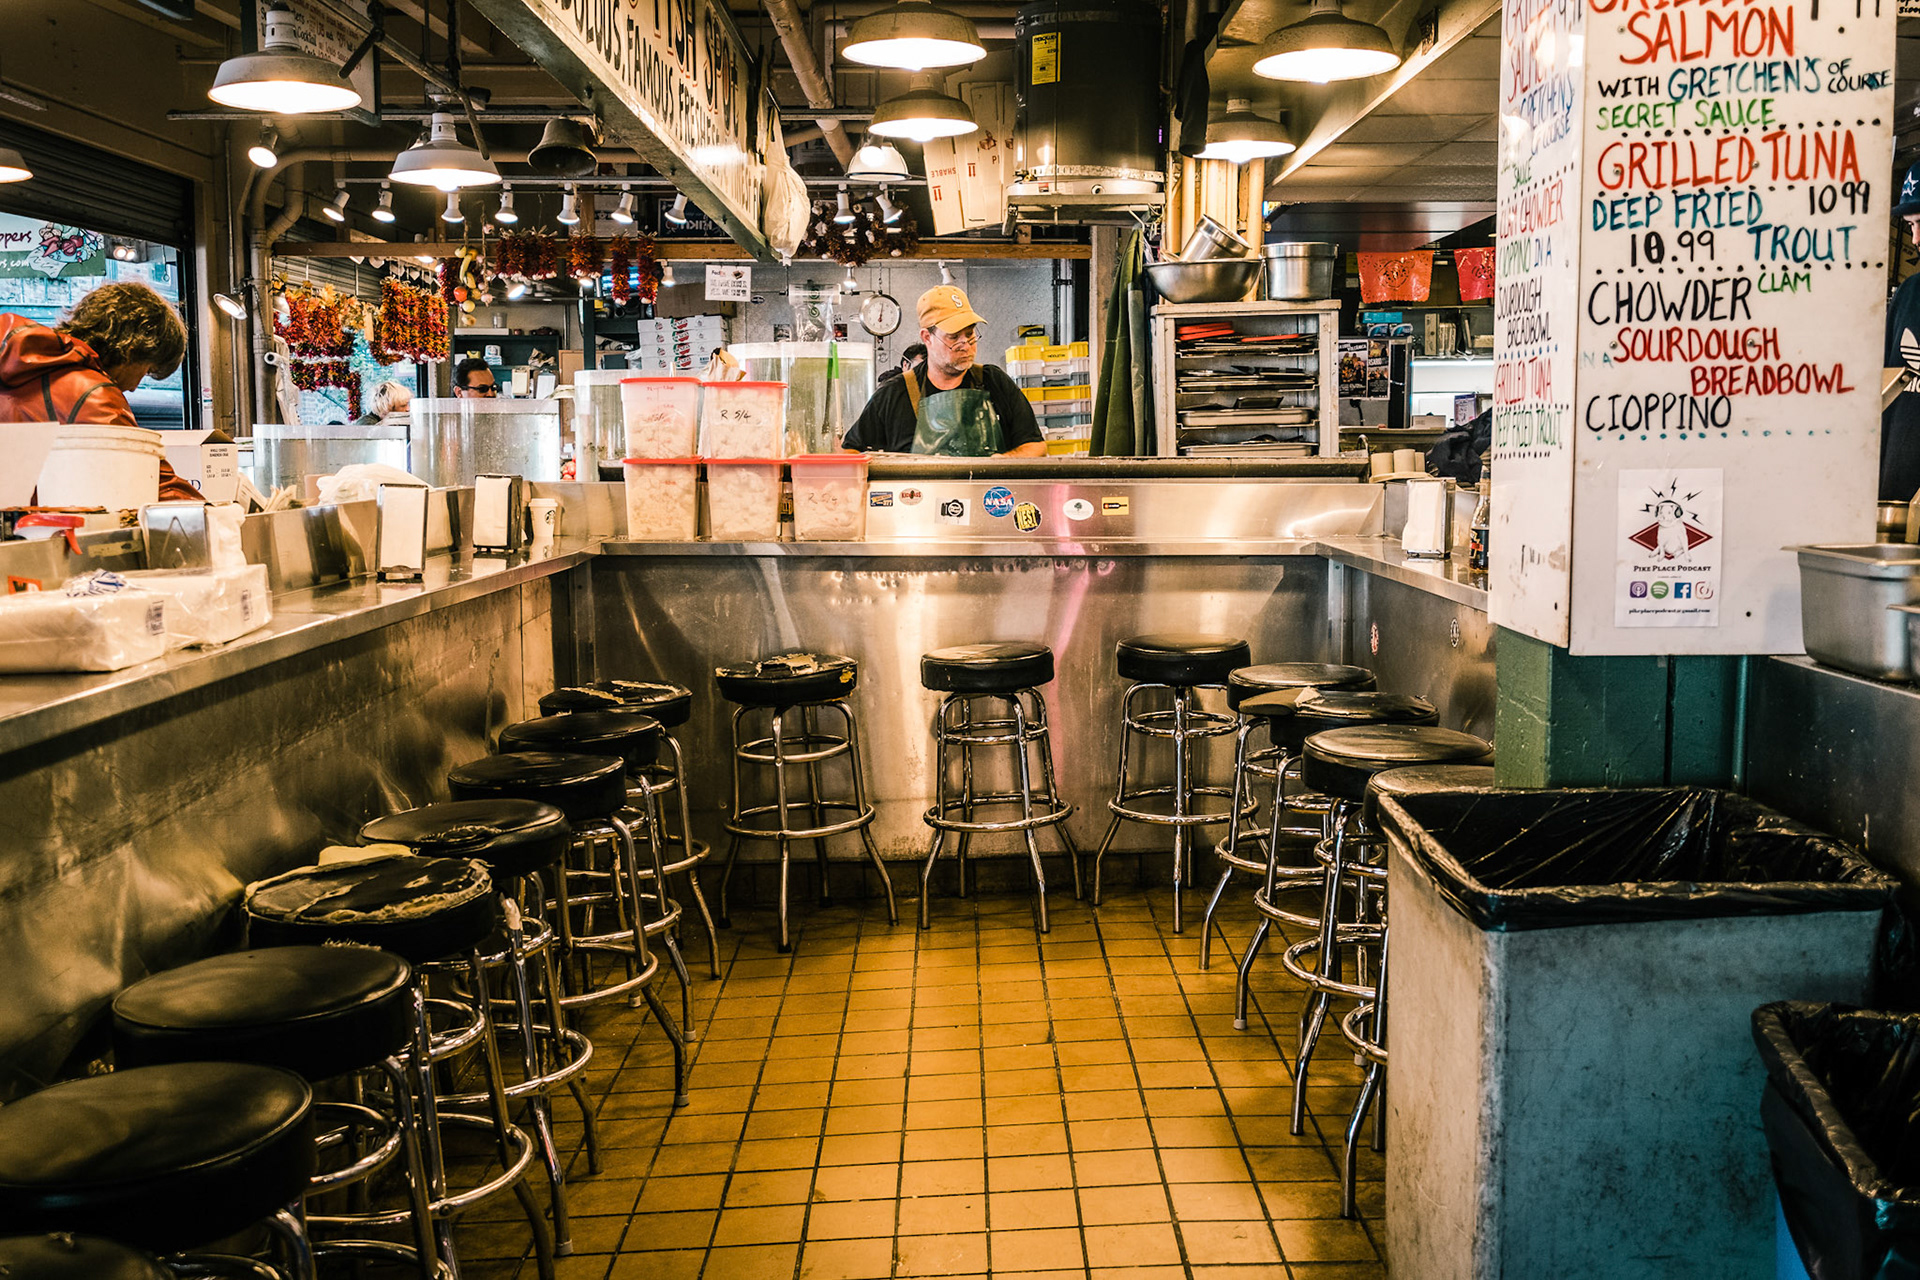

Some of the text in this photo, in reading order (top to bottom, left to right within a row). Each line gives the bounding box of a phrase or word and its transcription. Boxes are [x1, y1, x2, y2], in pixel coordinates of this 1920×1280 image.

[1619, 5, 1795, 65] SALMON
[1597, 56, 1821, 102] WITH GRETCHEN'S
[1828, 58, 1852, 75] OF
[1828, 69, 1893, 93] COURSE
[1596, 98, 1776, 130] SECRET SAUCE
[1597, 129, 1862, 190] GRILLED TUNA
[1593, 190, 1763, 232] DEEP FRIED
[1631, 223, 1858, 268] 10.99 TROUT
[952, 294, 963, 308] S
[1588, 272, 1811, 325] CHOWDER CLAM
[1507, 312, 1552, 348] BREADBOWL
[1613, 326, 1781, 363] SOURDOUGH
[1529, 356, 1553, 405] TUNA
[1691, 363, 1855, 396] BREADBOWL
[1586, 392, 1732, 432] CIOPPINO
[985, 498, 1012, 507] NASA
[1677, 564, 1711, 572] PODCAST
